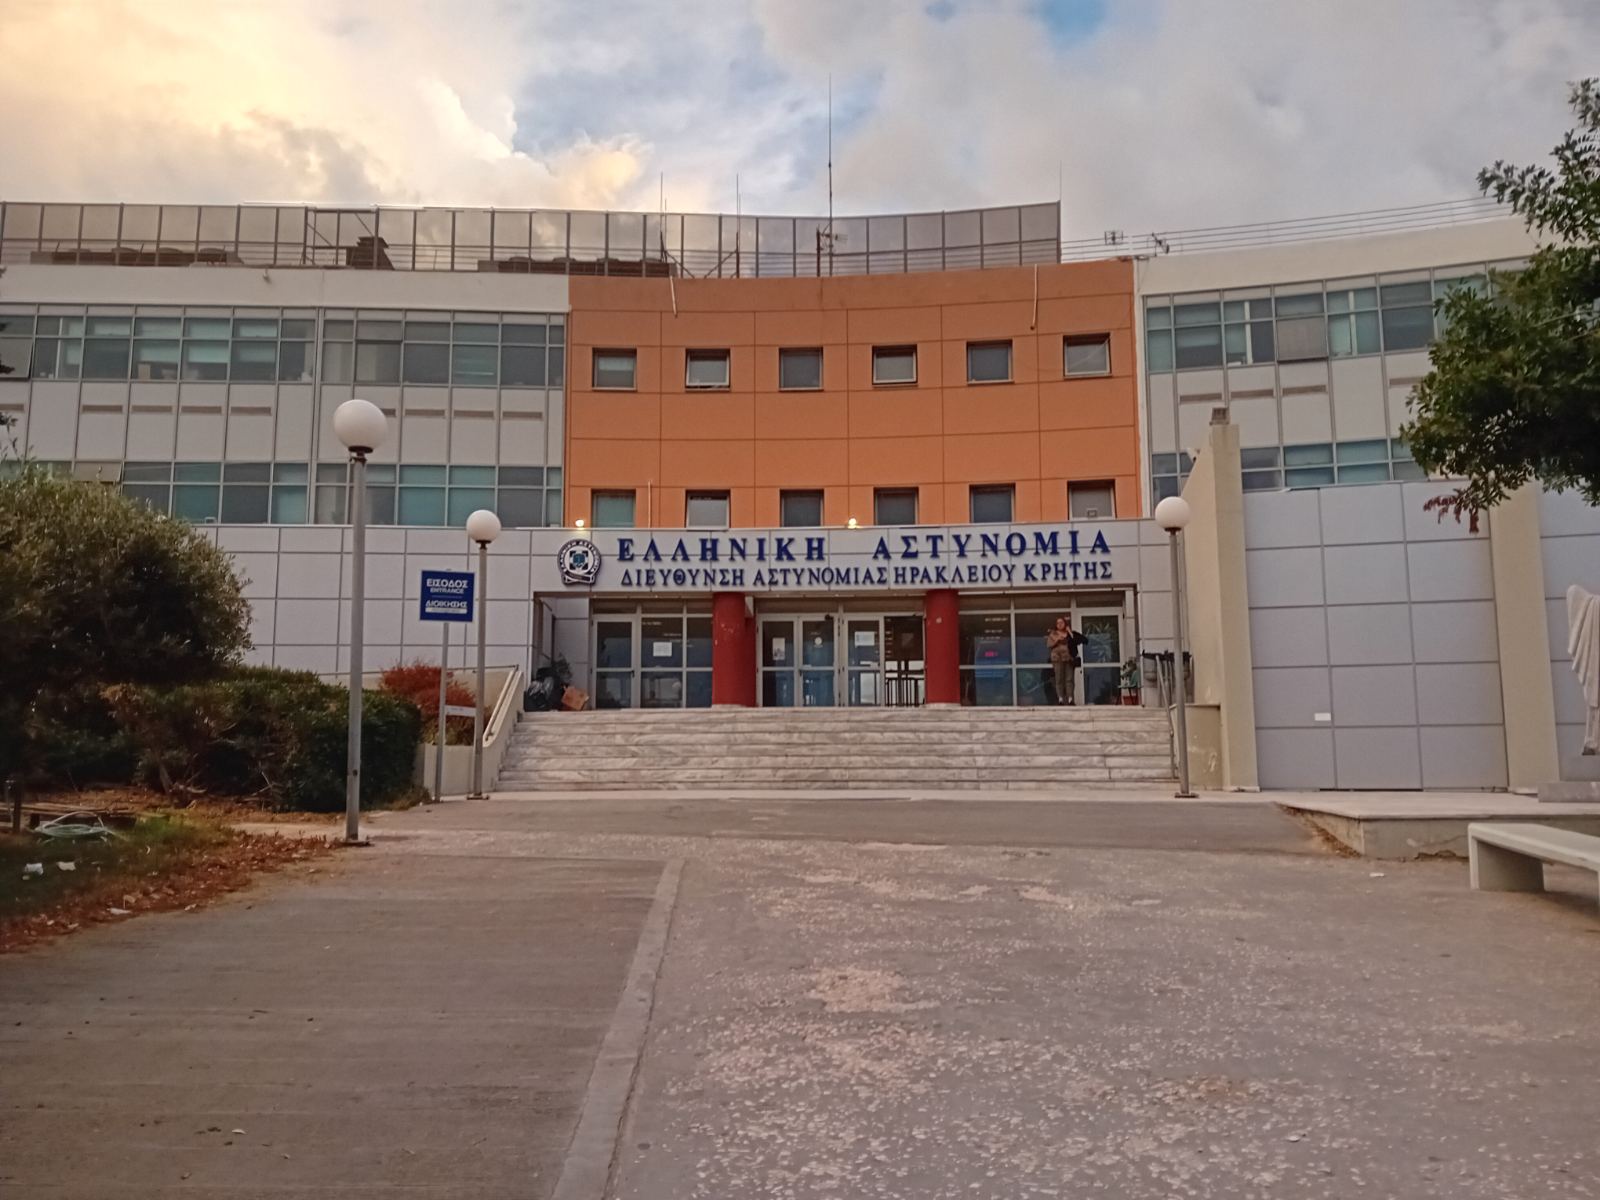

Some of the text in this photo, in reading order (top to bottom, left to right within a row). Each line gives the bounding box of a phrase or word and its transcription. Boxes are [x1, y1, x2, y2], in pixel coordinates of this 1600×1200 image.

[617, 529, 1111, 562] ΕΛΛΗΝΙΚΗ ΑΣΤΥΝΟΜΙΑ
[427, 579, 468, 588] ΕΙΣΟΔΟΣ
[621, 561, 1113, 586] ΔΙΕΥΘΥΝΣΗ ΑΣΤΥΝΟΜΙΑΣ ΗΡΑΚΛΕΙΟΥ ΚΡΗΤΗΣ
